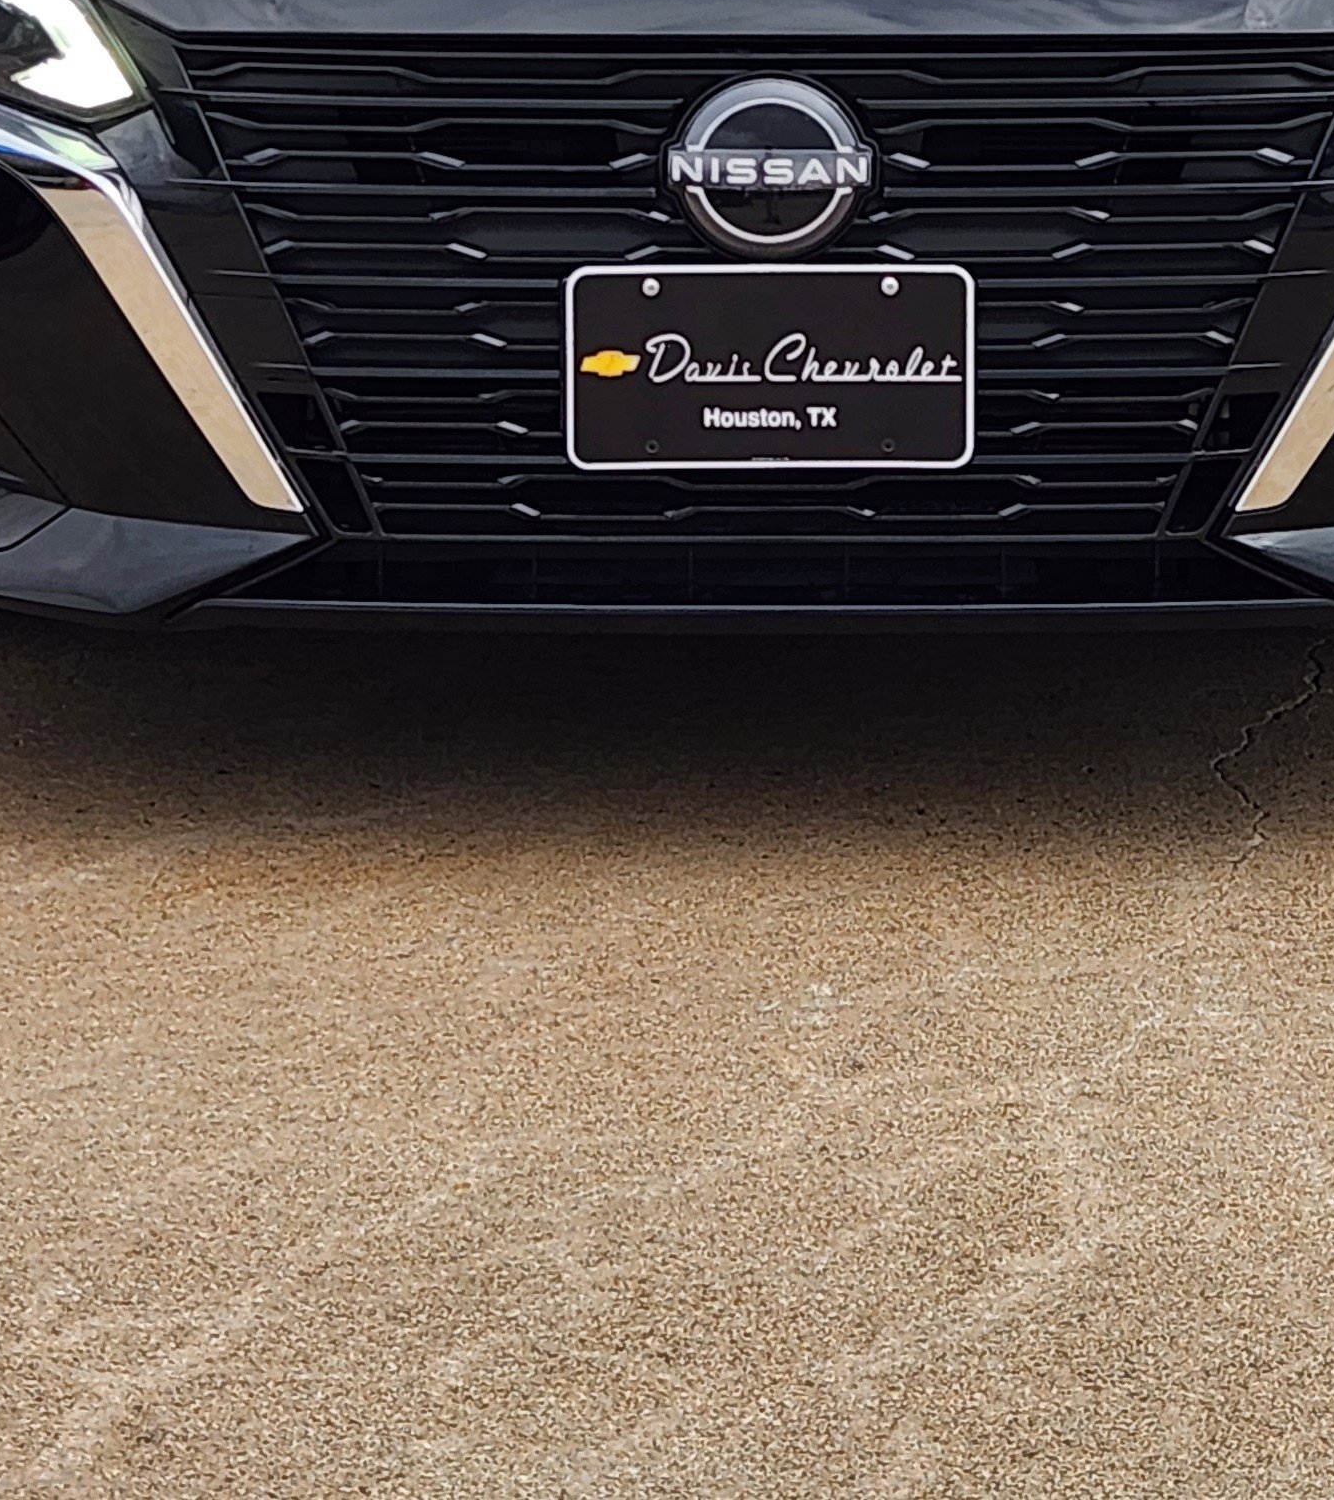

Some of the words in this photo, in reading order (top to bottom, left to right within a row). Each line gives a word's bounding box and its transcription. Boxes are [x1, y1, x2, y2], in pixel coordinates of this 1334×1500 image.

[671, 156, 869, 185] NISSAN
[645, 333, 762, 383] Davis
[764, 333, 962, 383] Chevrolet
[703, 407, 802, 431] Houston,
[806, 407, 837, 428] TX
